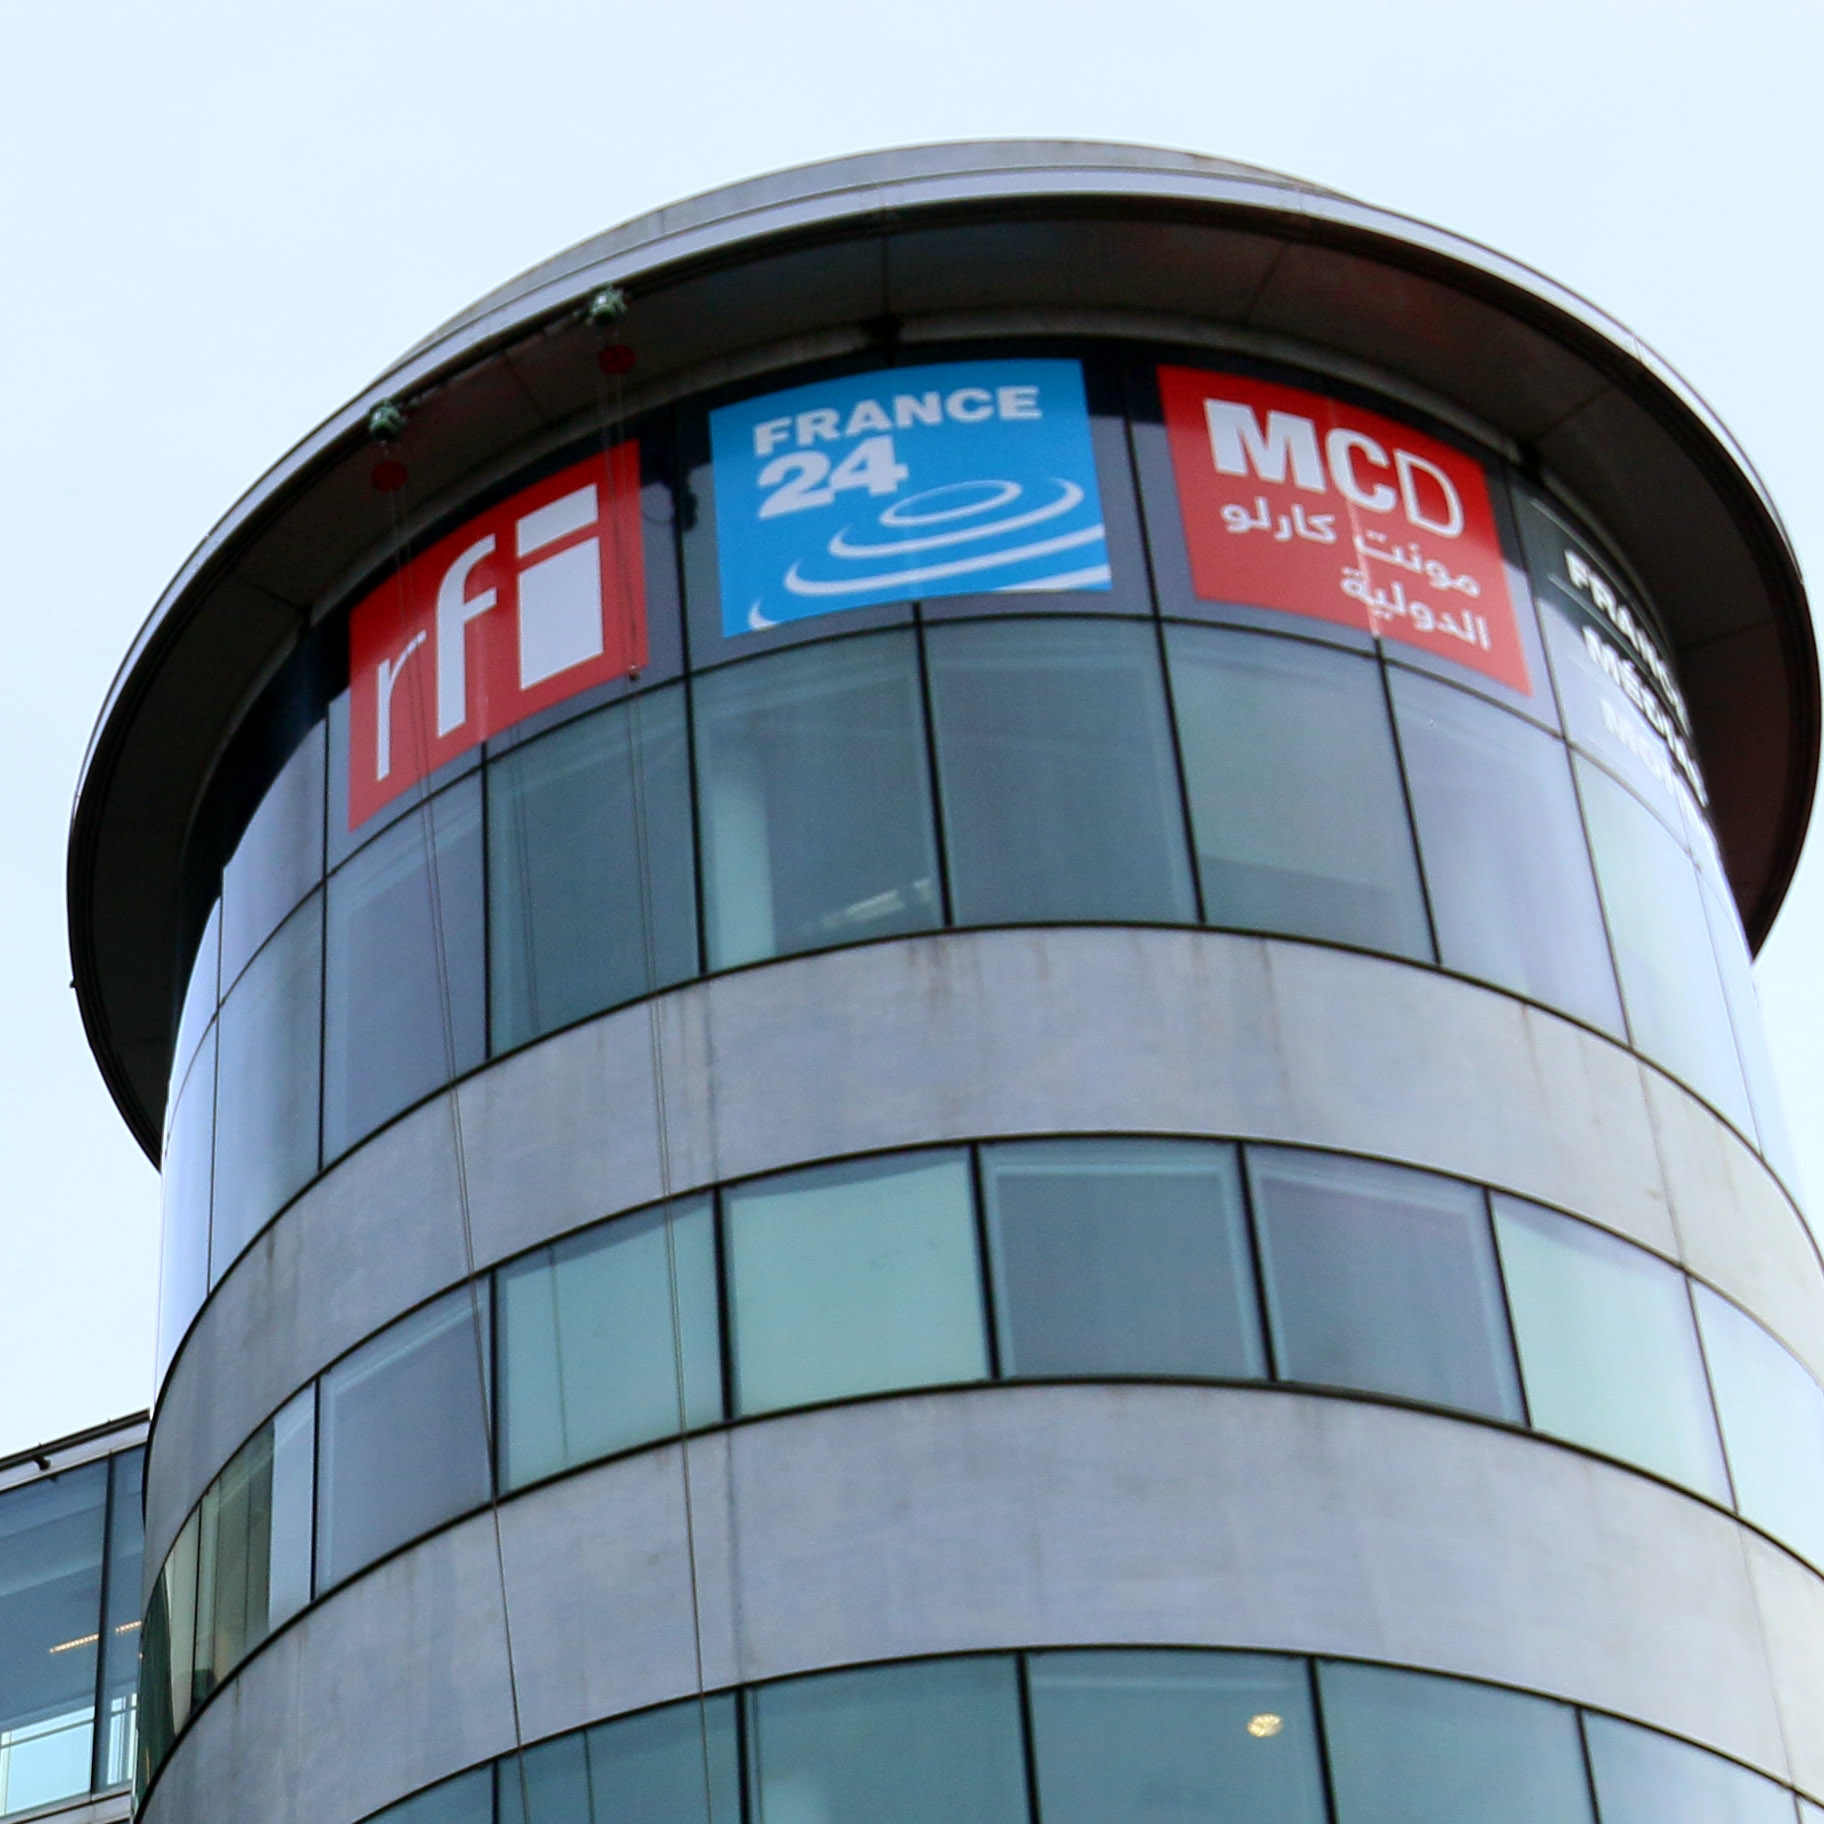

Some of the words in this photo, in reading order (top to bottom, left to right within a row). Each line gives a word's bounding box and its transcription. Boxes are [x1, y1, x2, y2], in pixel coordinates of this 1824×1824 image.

[753, 386, 1042, 456] FRANCE
[758, 434, 909, 520] 24
[1205, 398, 1464, 538] MCD
[1220, 496, 1337, 544] كارلو
[1352, 529, 1481, 597] مونت
[377, 483, 604, 781] rfi
[1339, 565, 1491, 651] الدولية
